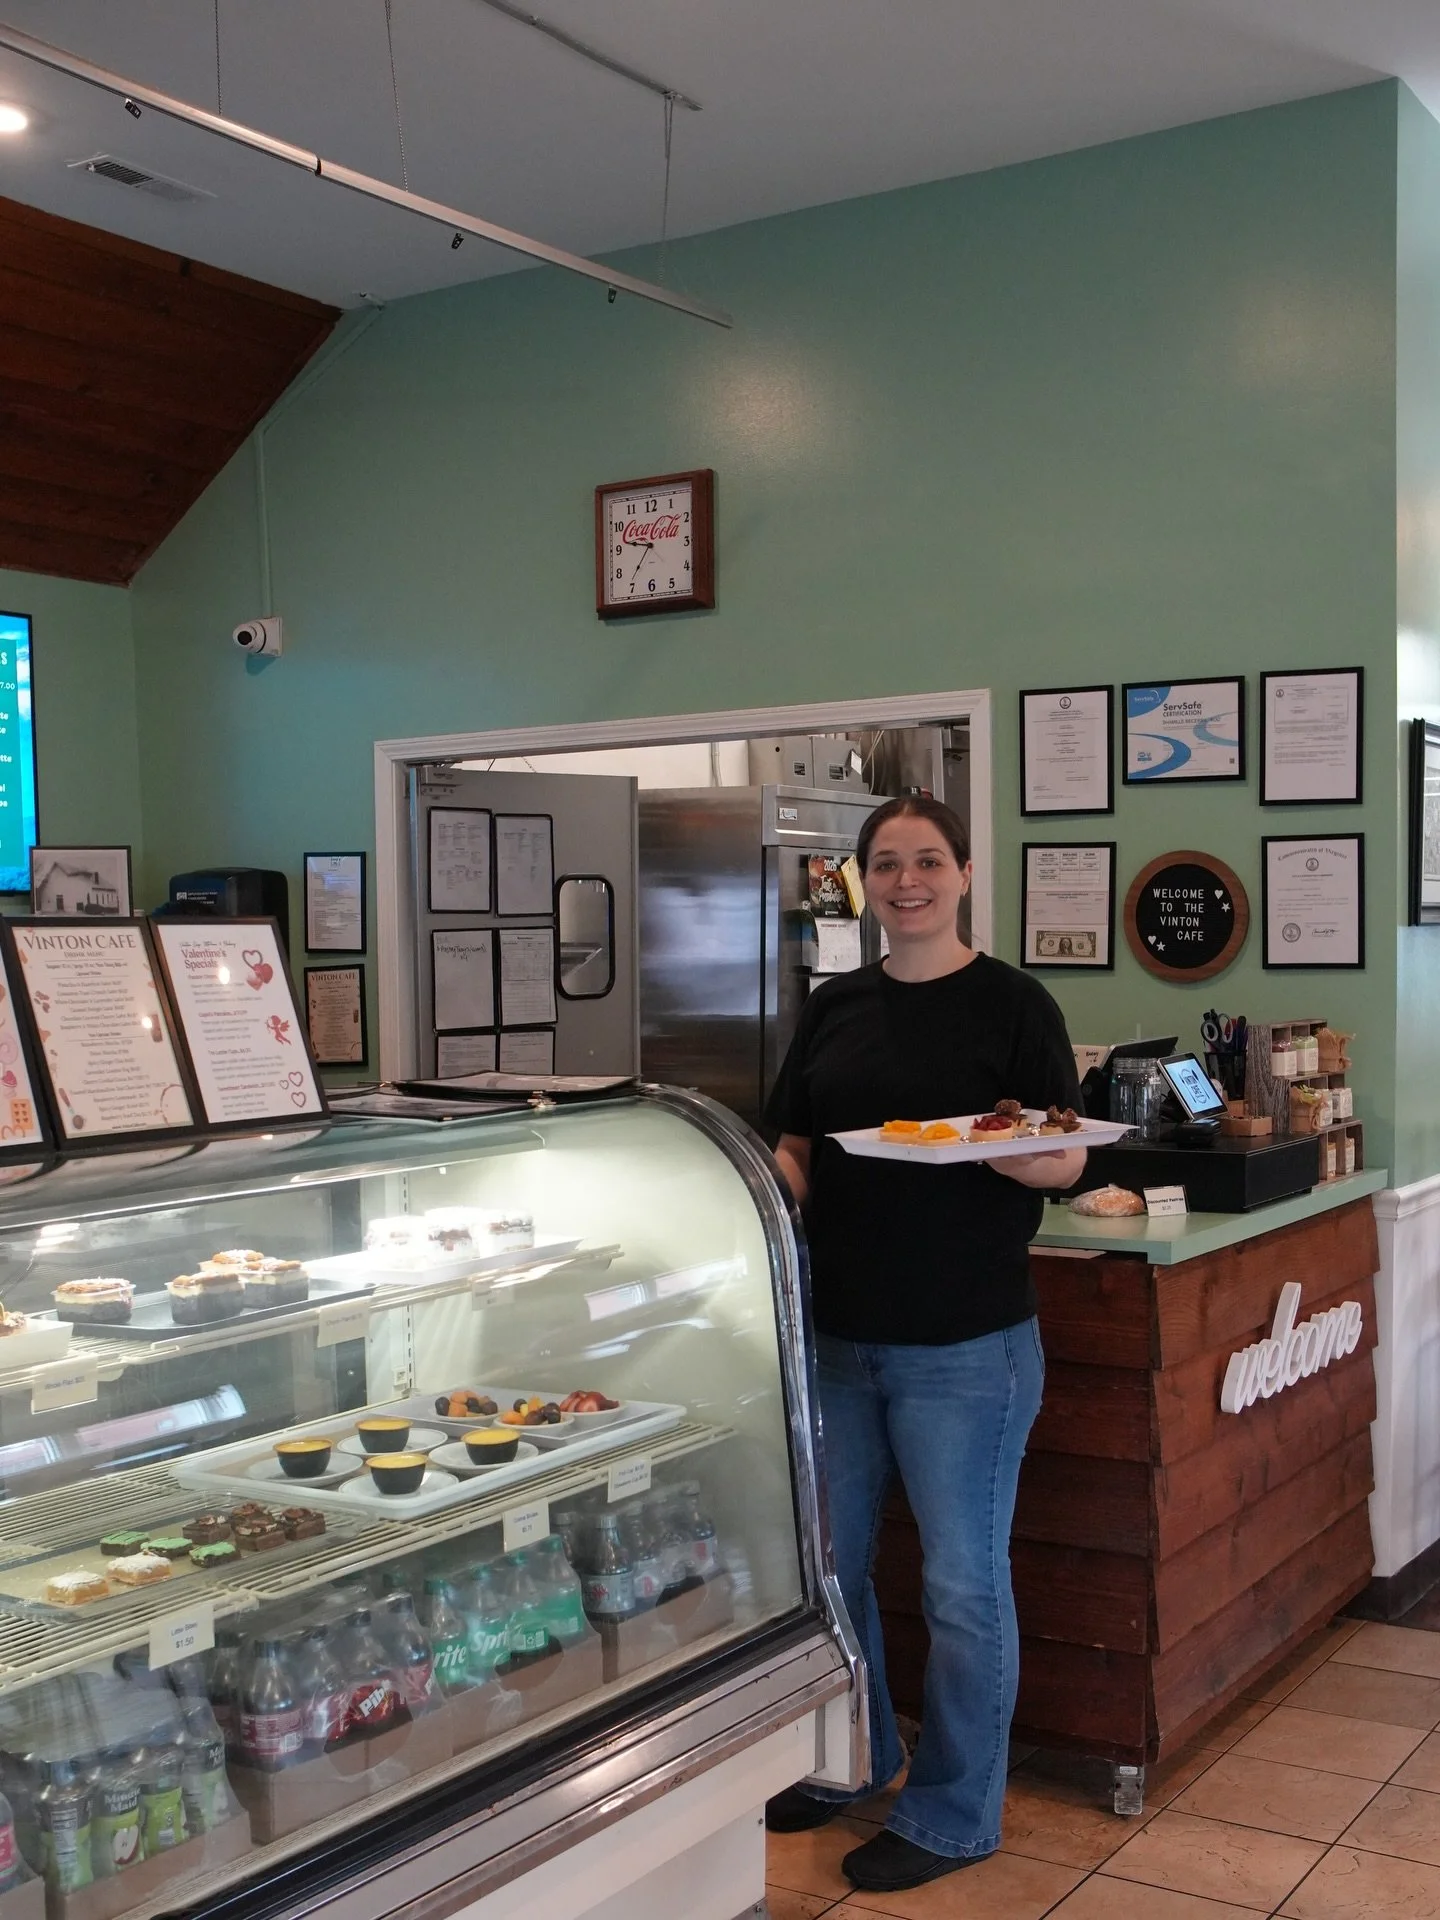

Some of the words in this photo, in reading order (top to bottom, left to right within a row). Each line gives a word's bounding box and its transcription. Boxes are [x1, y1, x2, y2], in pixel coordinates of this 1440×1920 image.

[627, 504, 636, 515] 11
[645, 499, 658, 513] 12
[669, 498, 673, 509] 1
[614, 522, 624, 532] 10
[622, 513, 682, 544] Coca-Cola
[683, 512, 690, 523] 2
[615, 545, 622, 556] 9
[683, 536, 690, 546] 3
[616, 568, 623, 579] 8
[629, 583, 635, 594] 7
[648, 579, 656, 592] 6
[668, 578, 675, 589] 5
[683, 560, 690, 571] 4
[1163, 701, 1202, 711] ServSafe
[1153, 888, 1205, 899] WELCOME
[1160, 902, 1173, 912] TO
[1184, 902, 1205, 913] THE
[1160, 916, 1200, 927] VINTON
[23, 935, 93, 950] VINTON
[95, 934, 137, 949] CAFE
[1177, 930, 1204, 941] CAFE
[181, 947, 227, 959] Valentine's
[184, 959, 218, 972] Specials
[1221, 1282, 1363, 1415] welcome
[175, 1636, 194, 1649] $1.50
[110, 1796, 137, 1813] Maid
